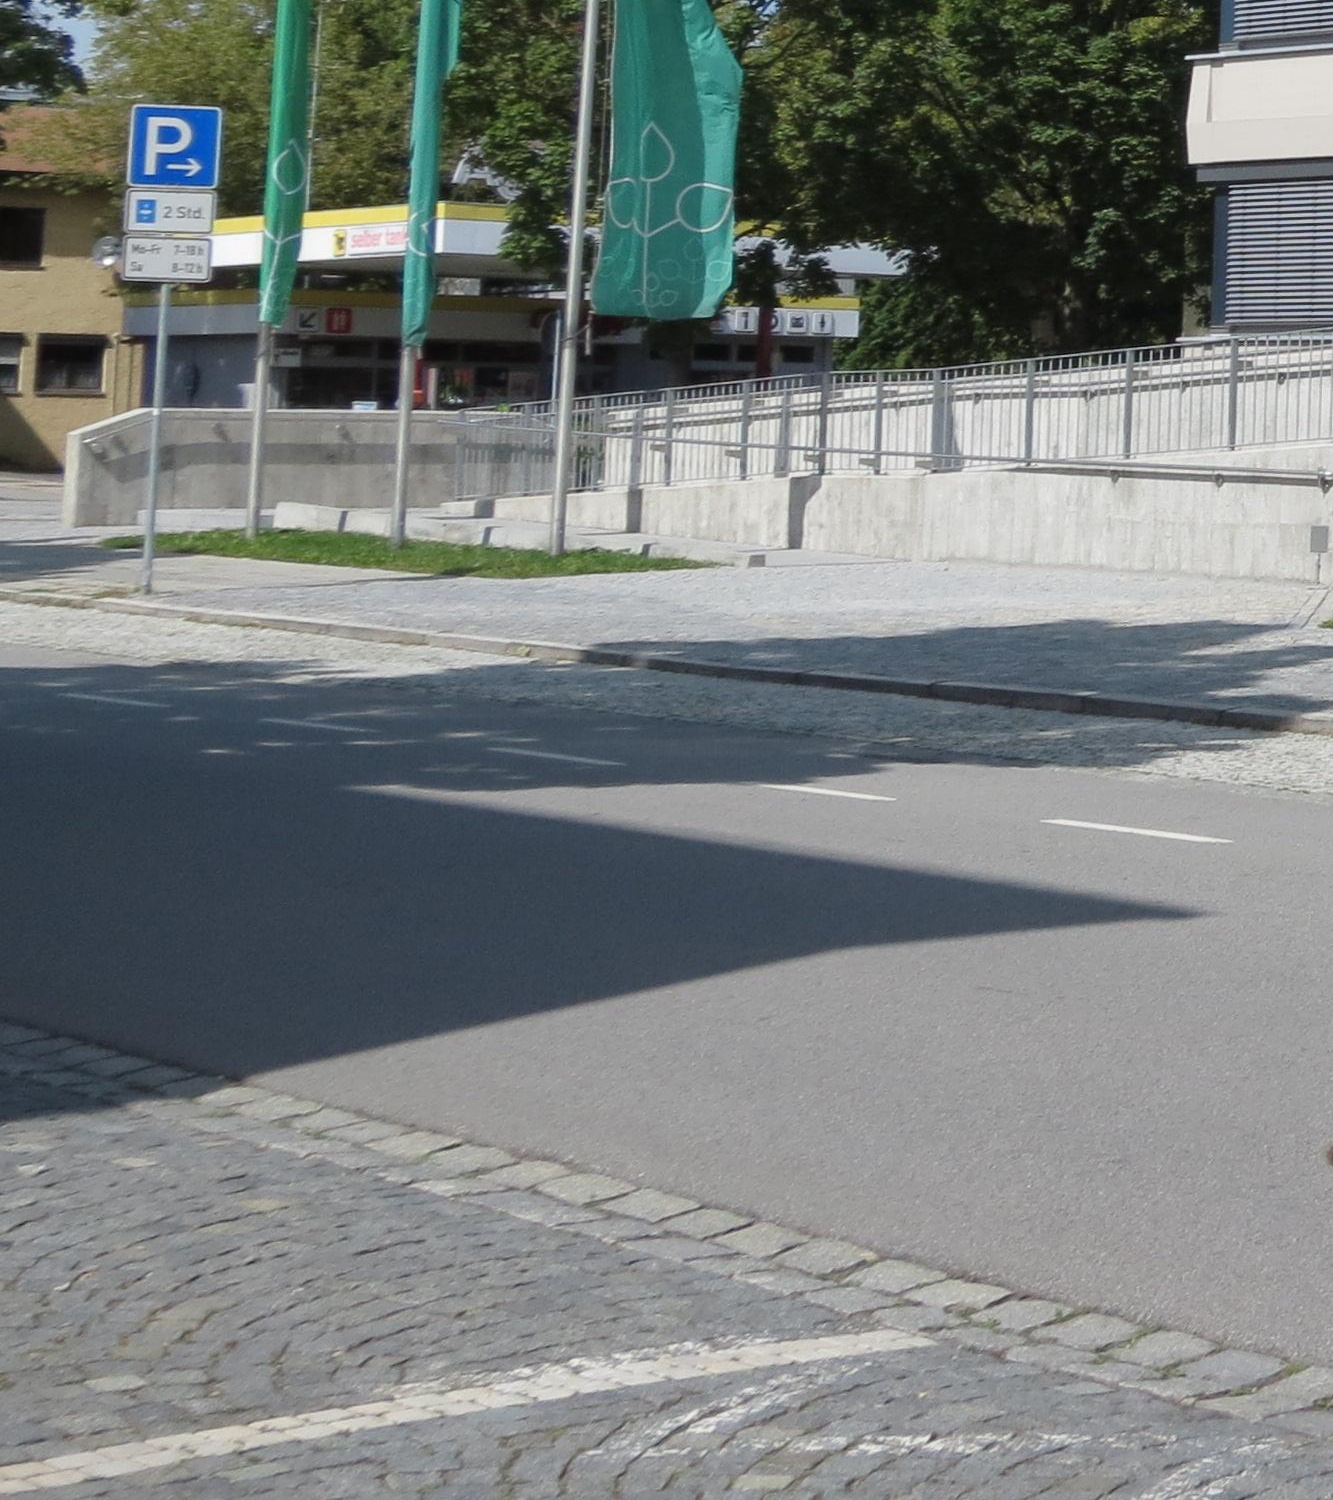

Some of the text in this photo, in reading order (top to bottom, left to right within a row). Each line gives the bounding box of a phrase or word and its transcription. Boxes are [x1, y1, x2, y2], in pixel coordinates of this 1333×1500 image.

[144, 116, 193, 175] P
[163, 205, 206, 220] 2 Std.
